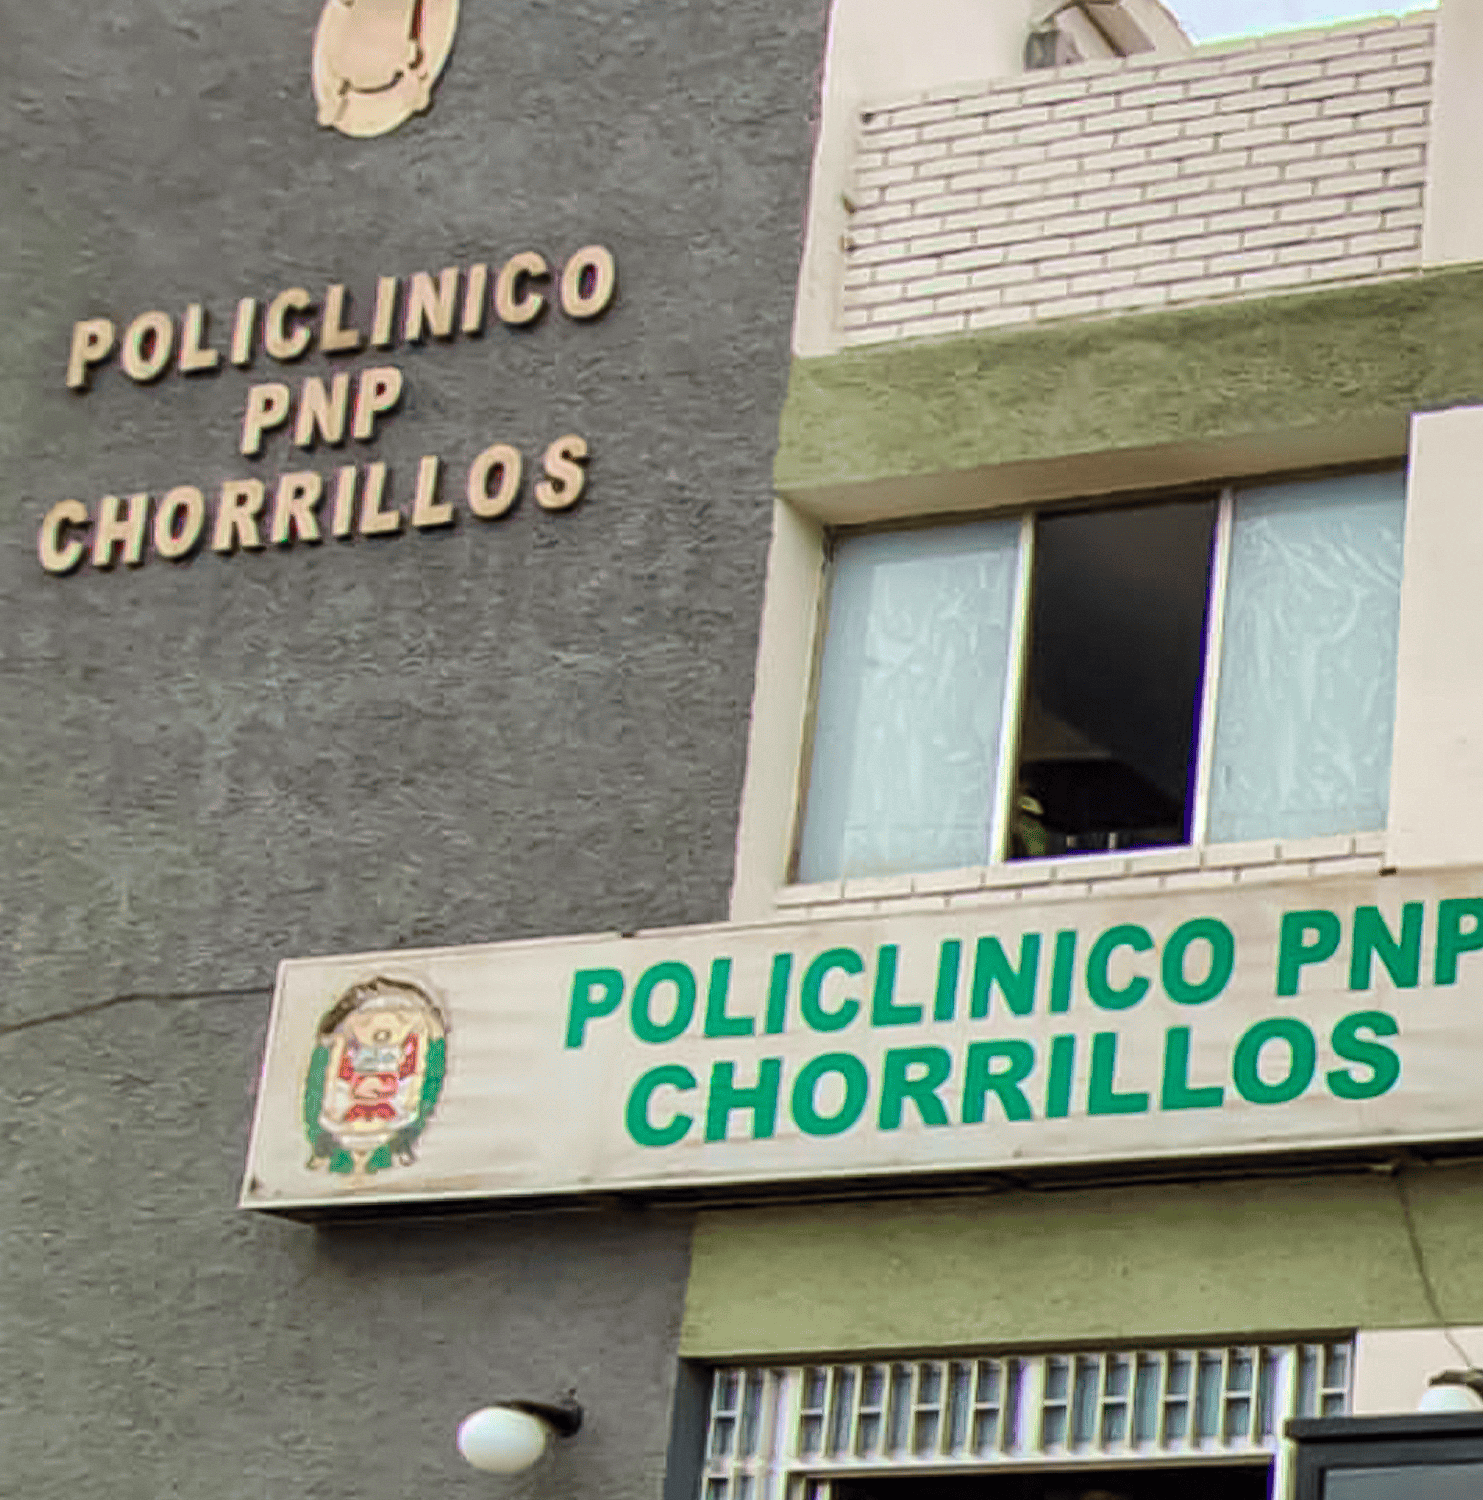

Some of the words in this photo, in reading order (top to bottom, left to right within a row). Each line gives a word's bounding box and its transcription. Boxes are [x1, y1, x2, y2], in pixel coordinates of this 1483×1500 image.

[66, 245, 616, 389] POLICLINICO
[240, 366, 403, 456] PNP
[39, 433, 589, 573] CHORRILLOS
[565, 915, 1236, 1050] POLICLINICO
[624, 1010, 1401, 1149] CHORRILLOS
